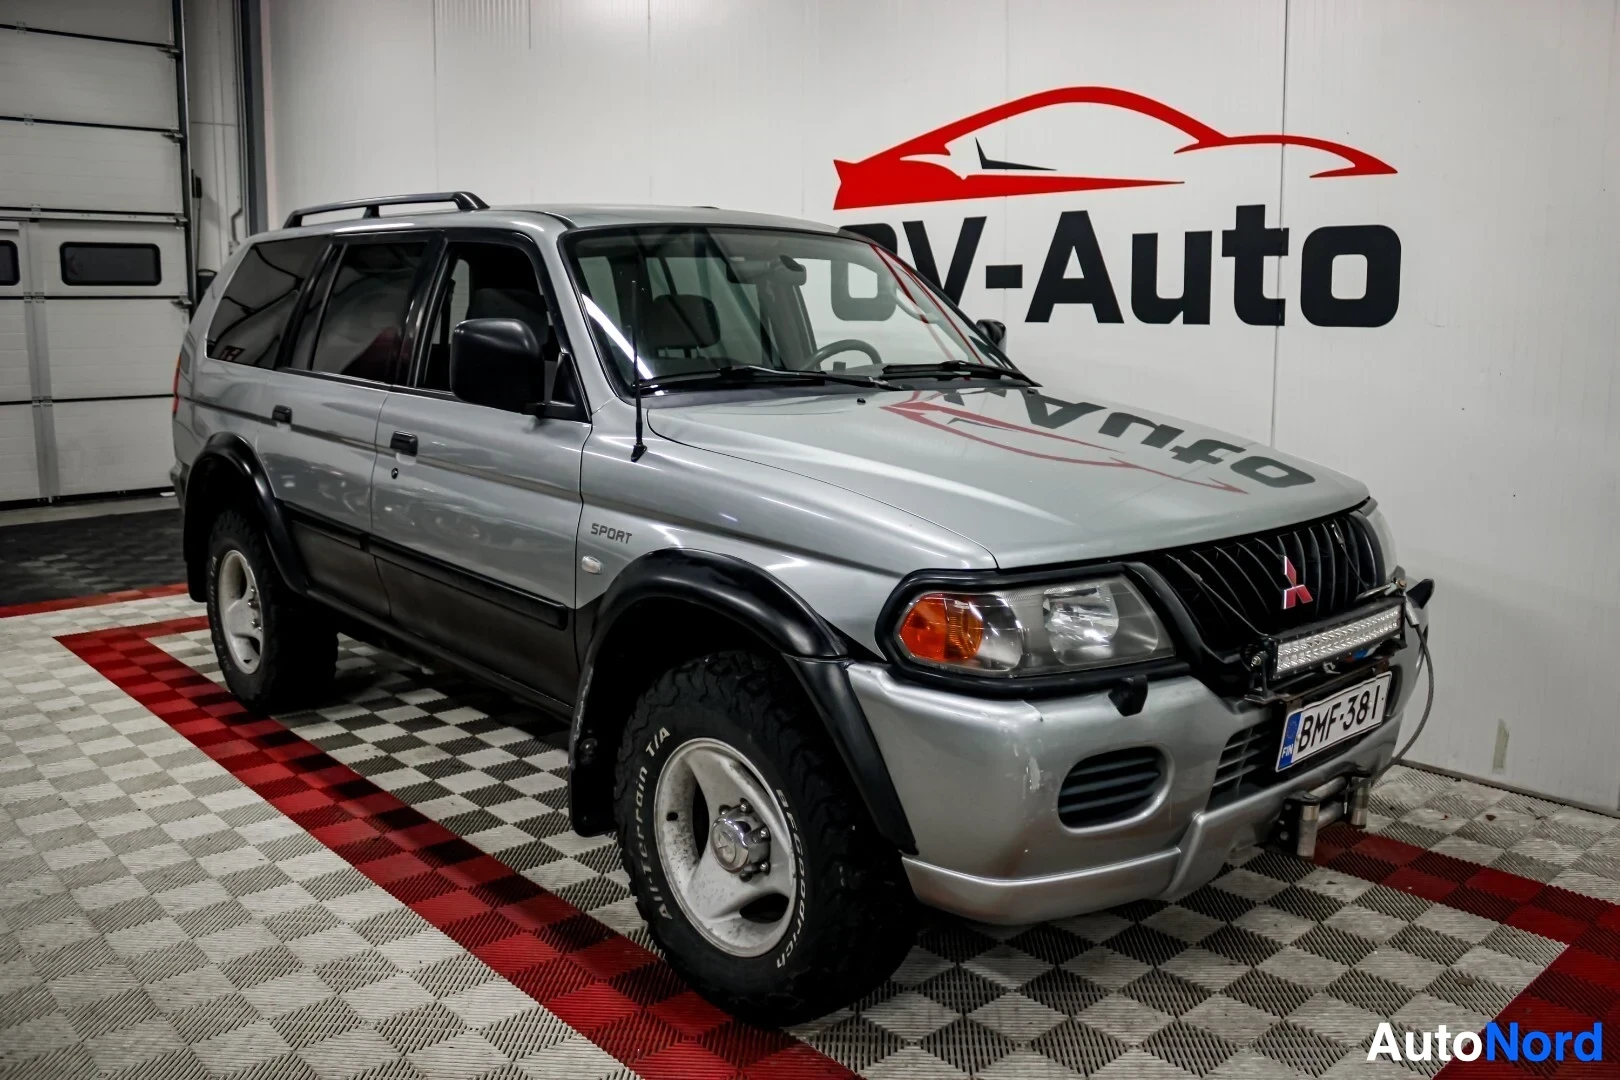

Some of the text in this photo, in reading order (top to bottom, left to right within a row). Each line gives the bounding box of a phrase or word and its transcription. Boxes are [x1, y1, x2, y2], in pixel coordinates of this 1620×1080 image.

[590, 522, 633, 544] SPORT
[1297, 685, 1381, 754] BMF-381
[645, 726, 671, 757] T/A
[1281, 744, 1294, 759] FIN
